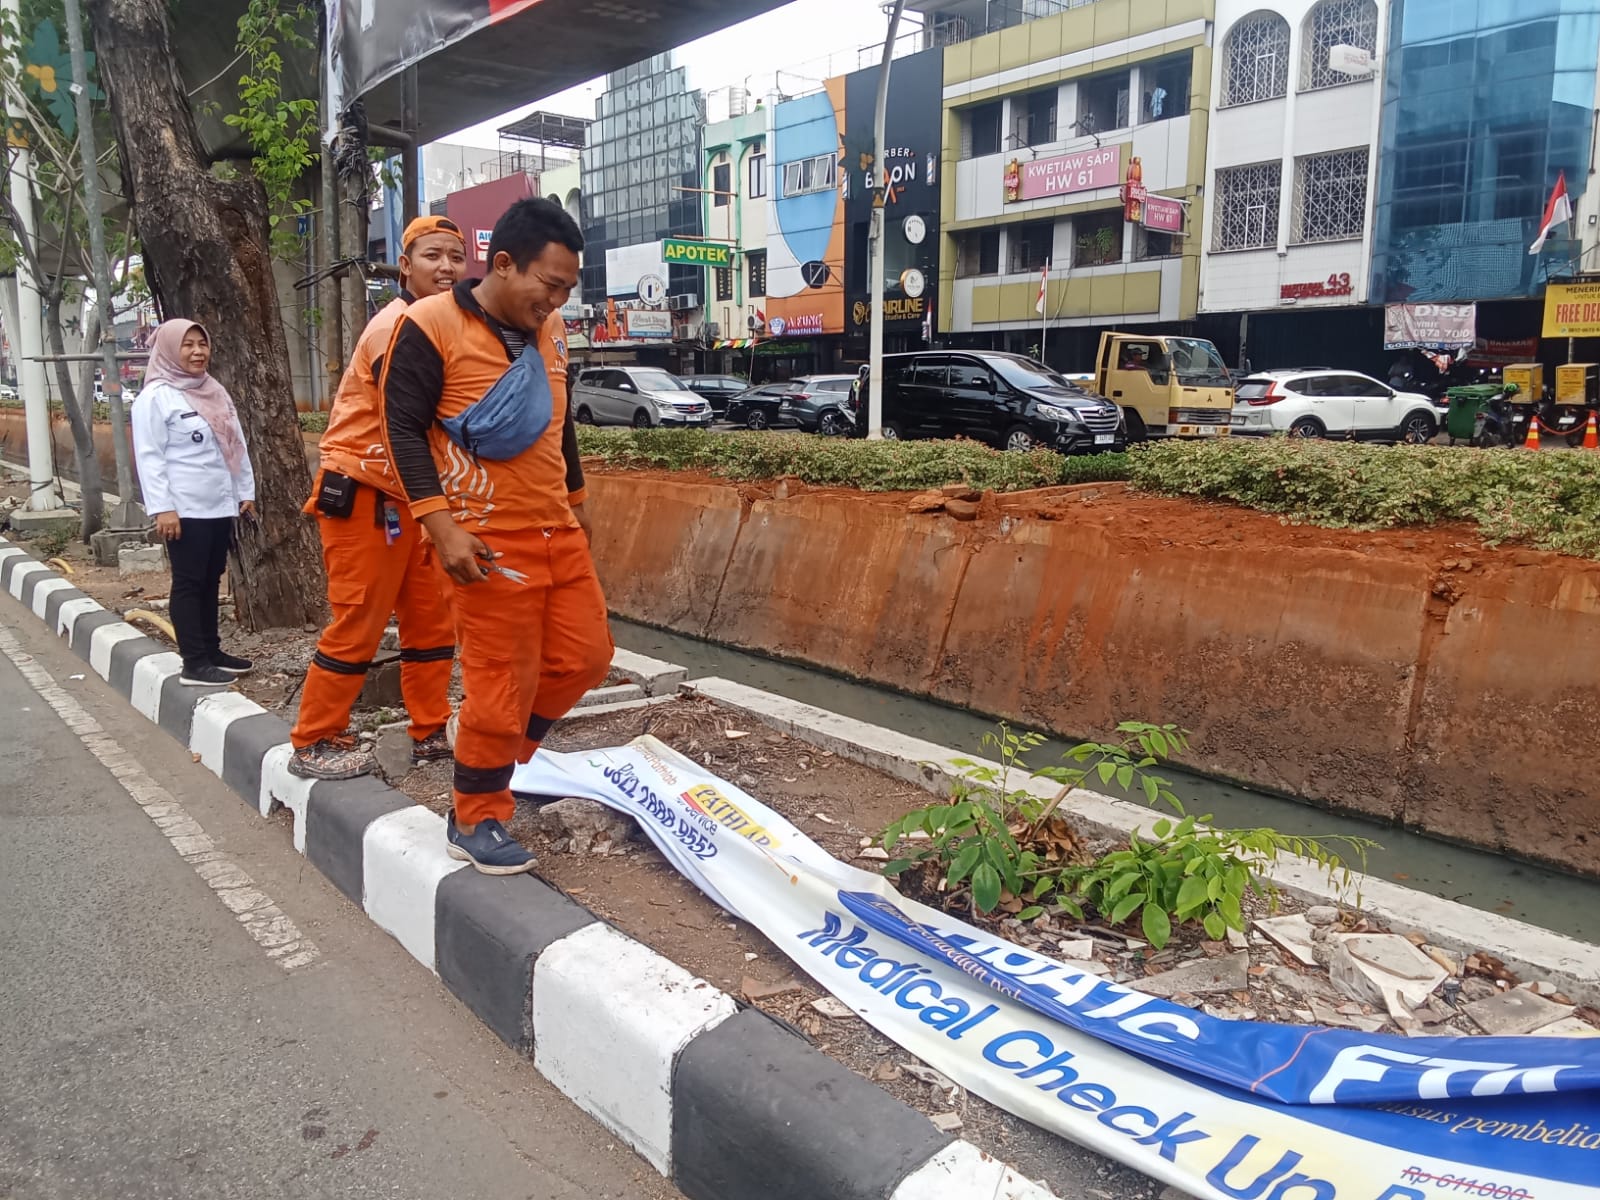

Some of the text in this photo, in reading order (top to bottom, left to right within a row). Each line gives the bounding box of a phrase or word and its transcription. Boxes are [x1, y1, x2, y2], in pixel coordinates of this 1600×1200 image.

[1029, 151, 1114, 178] KWETIAW SAPI
[1045, 169, 1094, 192] HW 61
[665, 244, 728, 262] APOTEK
[1327, 272, 1351, 288] 43
[1556, 303, 1580, 323] FREE
[637, 786, 676, 828] 2888
[672, 818, 718, 861] 9552
[797, 910, 1000, 1041] Medical
[982, 1030, 1211, 1163] Check
